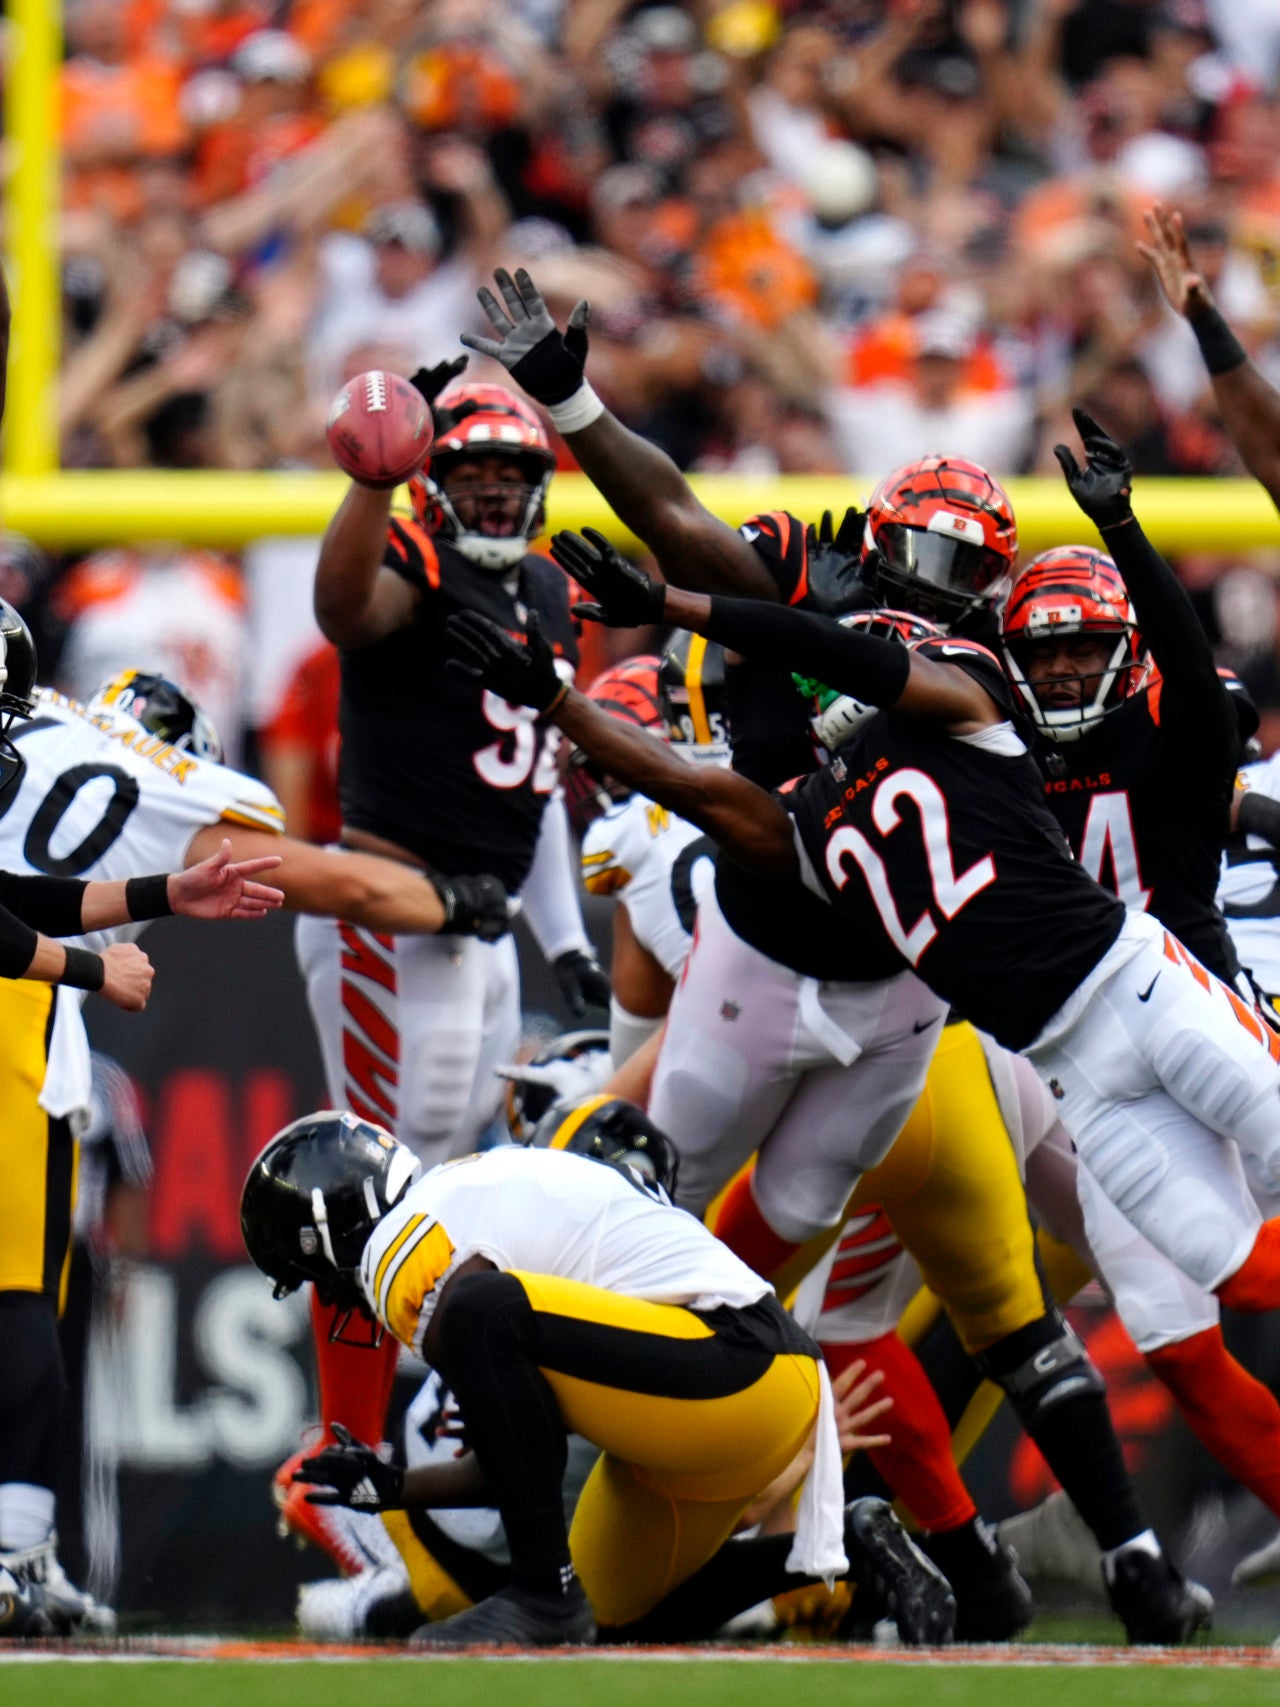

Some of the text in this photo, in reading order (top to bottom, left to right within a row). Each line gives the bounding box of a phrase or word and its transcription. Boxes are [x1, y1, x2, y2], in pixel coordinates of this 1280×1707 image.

[679, 712, 726, 744] 95
[825, 767, 997, 968] 22
[1066, 789, 1155, 913] 4
